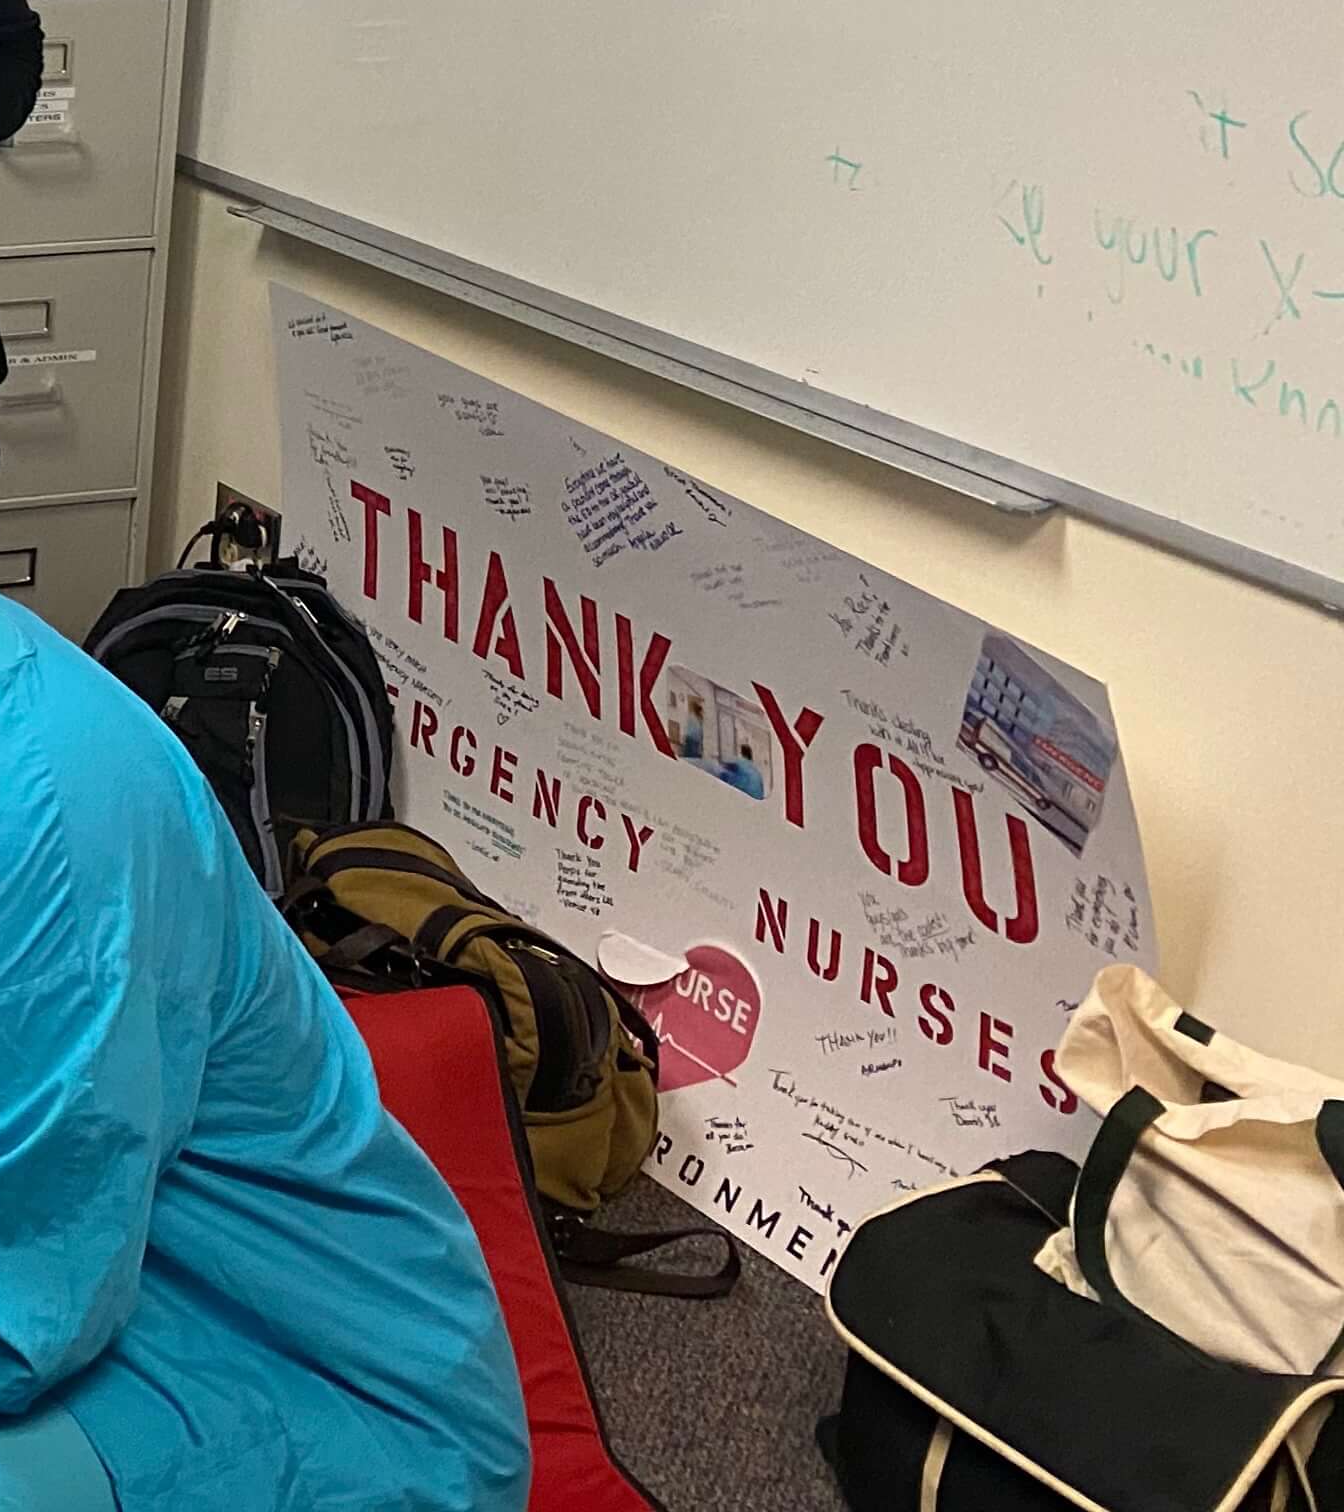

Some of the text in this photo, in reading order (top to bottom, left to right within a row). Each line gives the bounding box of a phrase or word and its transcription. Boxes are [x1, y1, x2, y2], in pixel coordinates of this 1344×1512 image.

[350, 479, 679, 762] THANK
[387, 683, 655, 874] RGENCY
[750, 680, 1040, 945] YOU
[754, 887, 1080, 1116] NURSES
